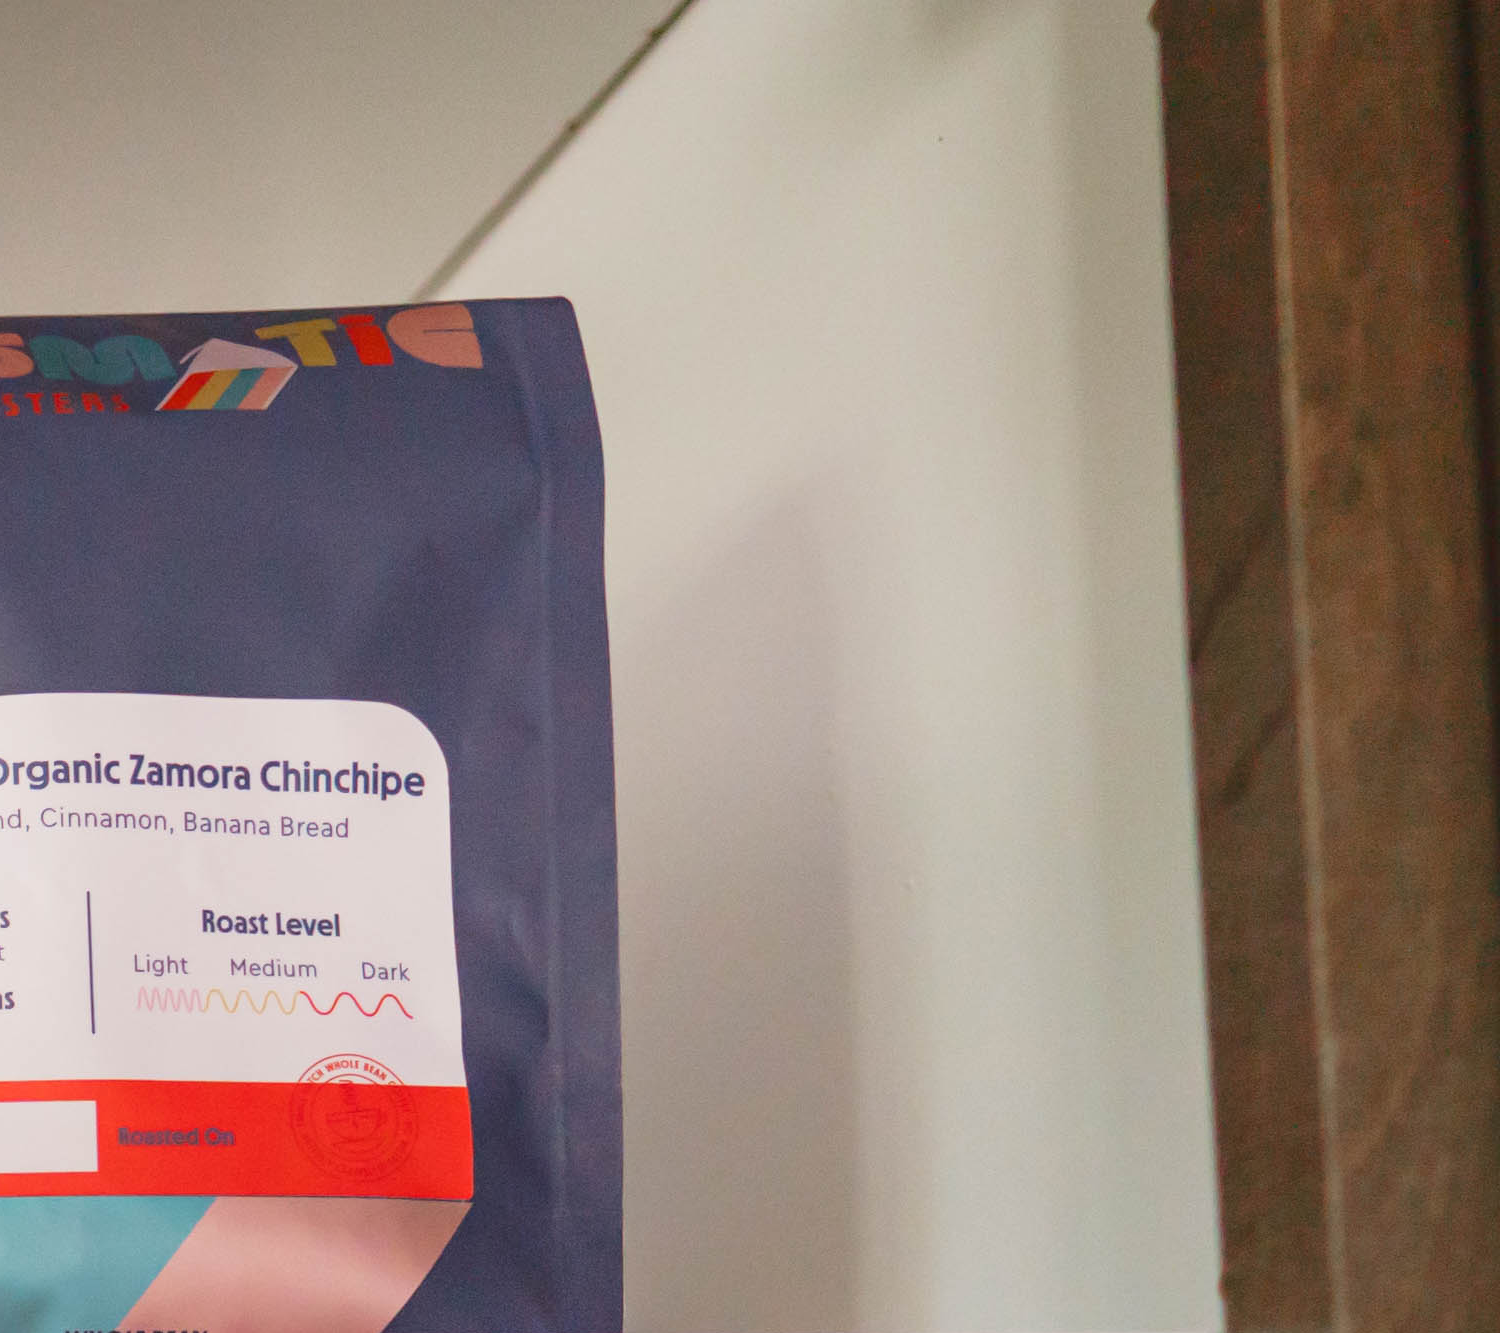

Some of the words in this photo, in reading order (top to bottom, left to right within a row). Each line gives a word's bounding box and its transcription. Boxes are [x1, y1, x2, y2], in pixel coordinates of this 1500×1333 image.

[130, 754, 252, 788] Zamora
[261, 759, 426, 800] Chinchipe
[40, 807, 176, 836] Cinnamon,
[184, 812, 271, 837] Banana
[280, 815, 350, 839] Bread
[201, 909, 269, 936] Roast
[276, 911, 341, 938] Level
[134, 954, 189, 977] Light
[230, 957, 318, 979] Medium
[361, 961, 411, 982] Dark
[325, 1059, 360, 1073] WHOLE
[363, 1063, 388, 1081] BEAN
[118, 1126, 199, 1146] Roasted
[204, 1127, 236, 1146] On
